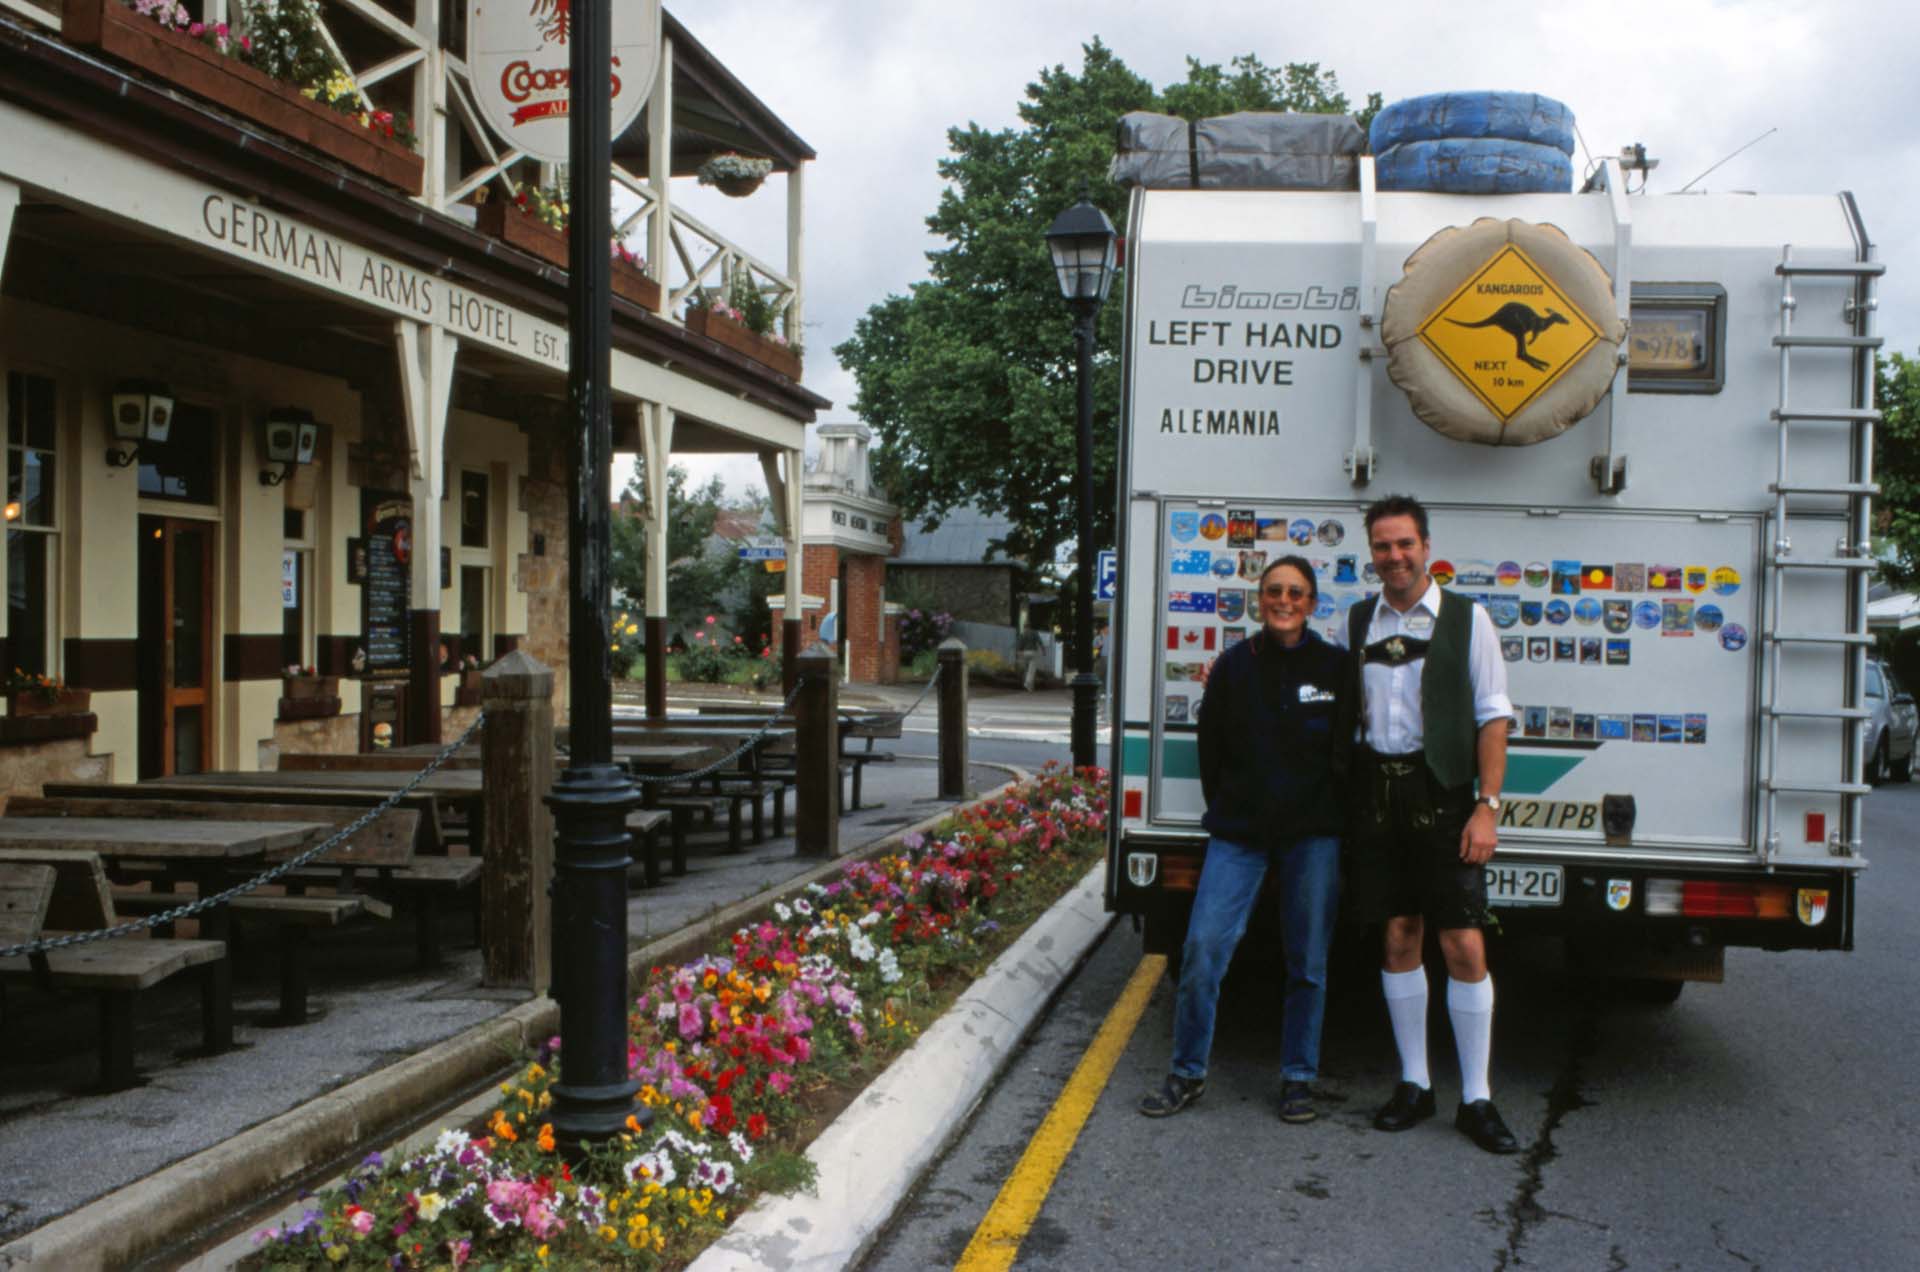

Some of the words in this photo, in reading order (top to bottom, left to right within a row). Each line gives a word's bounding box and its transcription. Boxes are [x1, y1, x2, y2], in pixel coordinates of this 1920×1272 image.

[203, 195, 342, 283] GERMAN
[360, 257, 433, 315] ARMS
[448, 289, 519, 346] HOTEL
[534, 330, 560, 361] EST.
[1477, 284, 1544, 295] KANGAROOS
[1181, 285, 1360, 311] bimobi
[1149, 320, 1232, 347] LEFT
[1246, 323, 1342, 349] HAND
[1194, 359, 1293, 385] DRIVE
[1474, 361, 1507, 371] NEXT
[1493, 378, 1505, 387] 10
[1160, 408, 1280, 436] ALEMANIA
